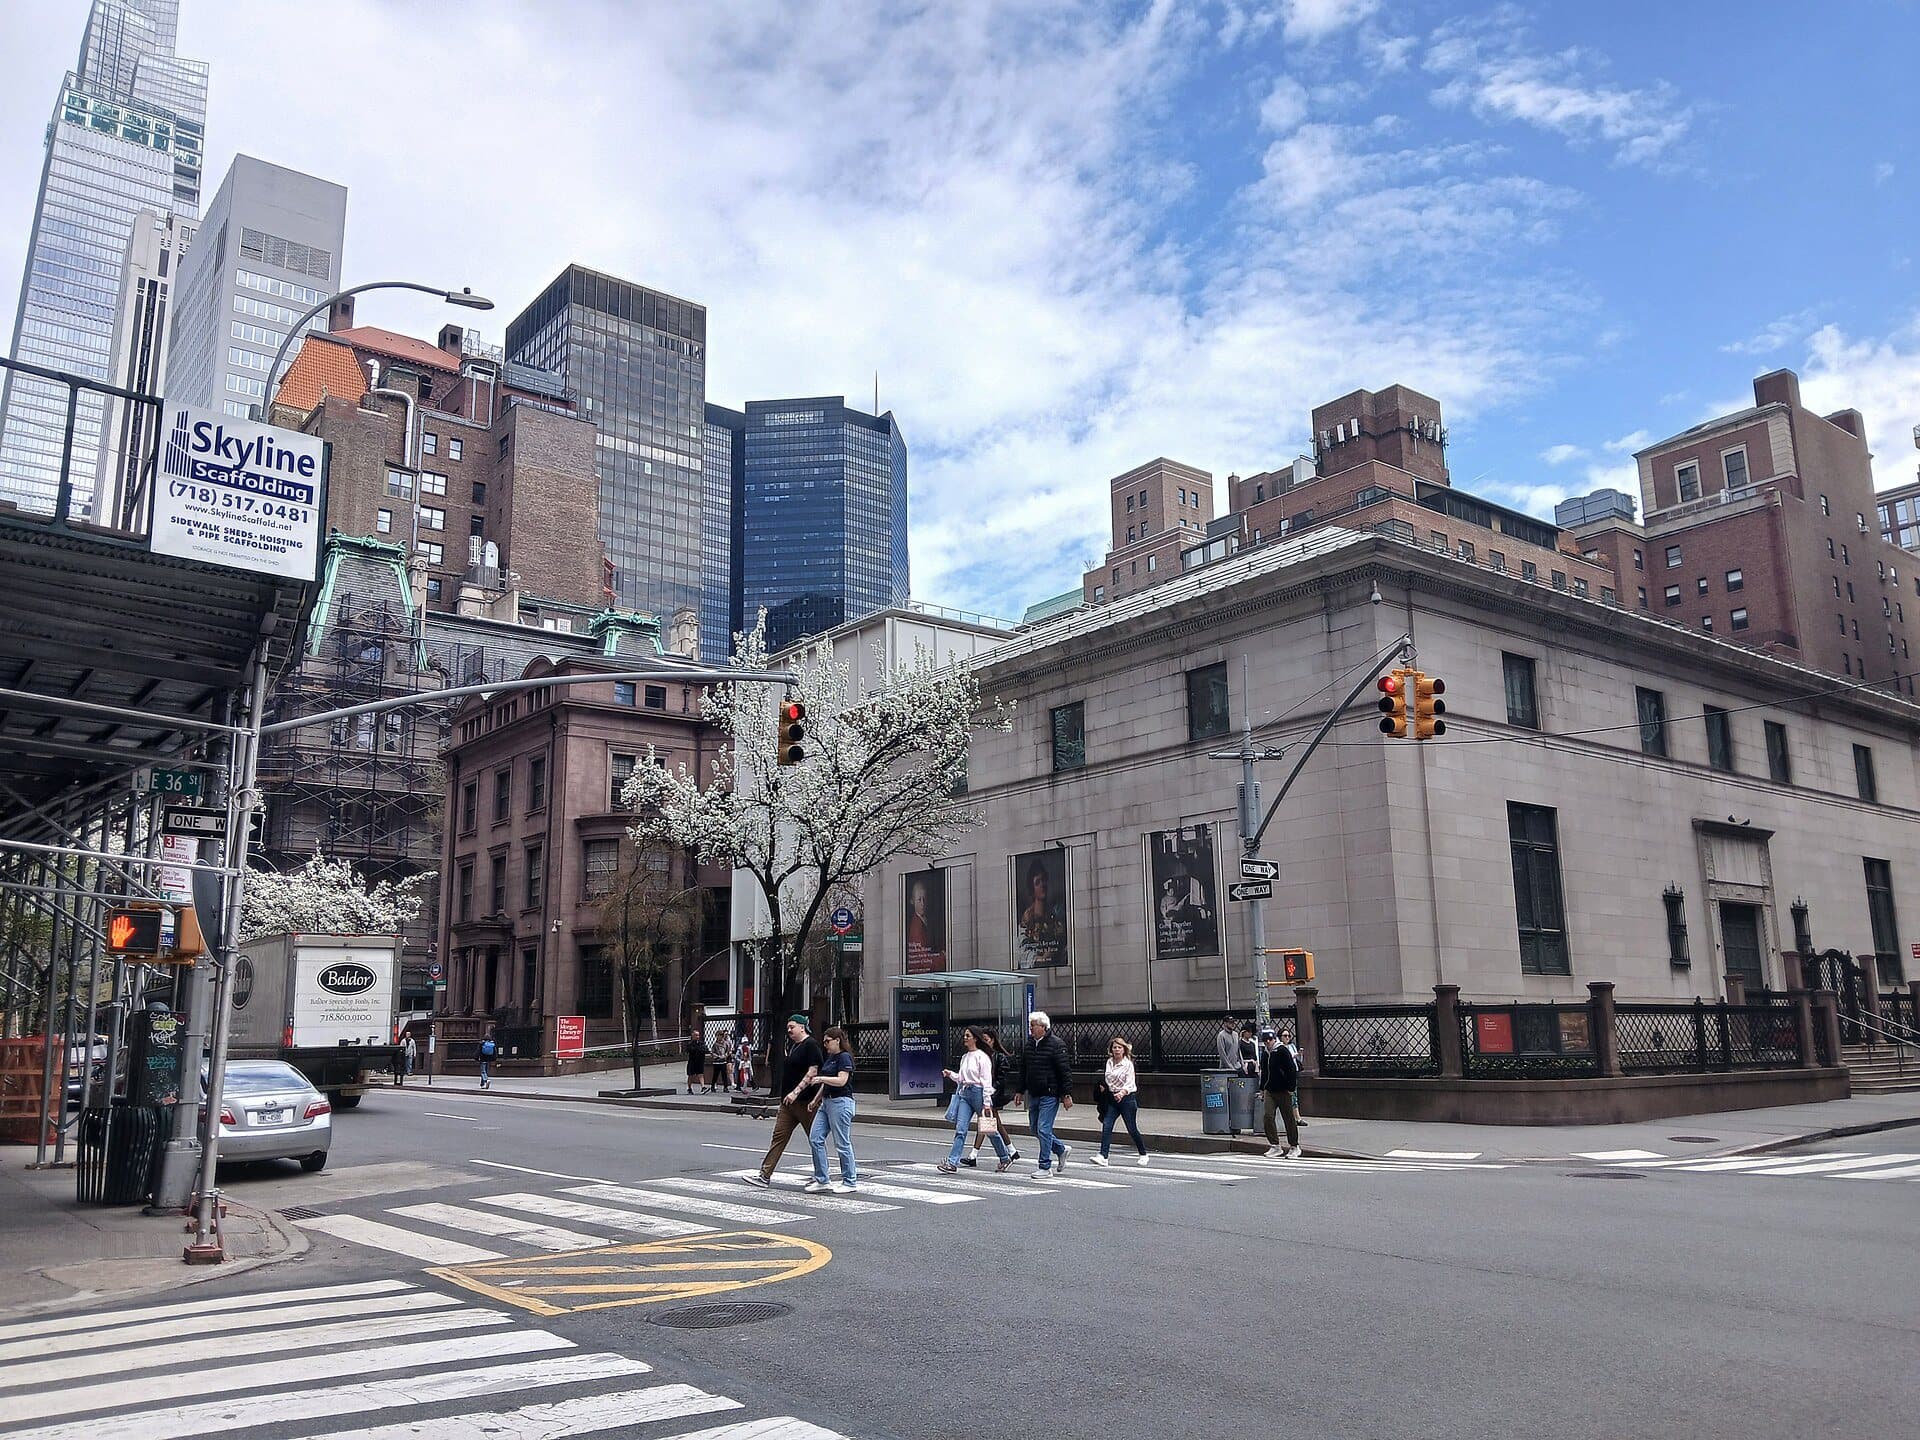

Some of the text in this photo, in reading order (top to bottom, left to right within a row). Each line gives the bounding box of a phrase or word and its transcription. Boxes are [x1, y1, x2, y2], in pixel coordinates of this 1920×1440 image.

[192, 421, 316, 478] Skyline
[195, 462, 308, 501] Scaffolding
[169, 480, 309, 524] (718) 517.0481
[184, 504, 293, 532] www.SkylineScaffold.net
[170, 516, 303, 549] SIDEWALK SHEDS HOISTING
[187, 528, 287, 554] & PIPE SCAFFOLDING
[150, 772, 198, 792] E 36 St
[174, 815, 201, 828] ONE
[166, 837, 173, 848] 3
[1245, 865, 1256, 873] ONE
[1236, 886, 1268, 896] ONE WAY
[327, 970, 371, 986] Baldor
[319, 1013, 372, 1023] 718.860.9100
[902, 1020, 921, 1030] Target
[902, 1043, 940, 1052] Streaming TV
